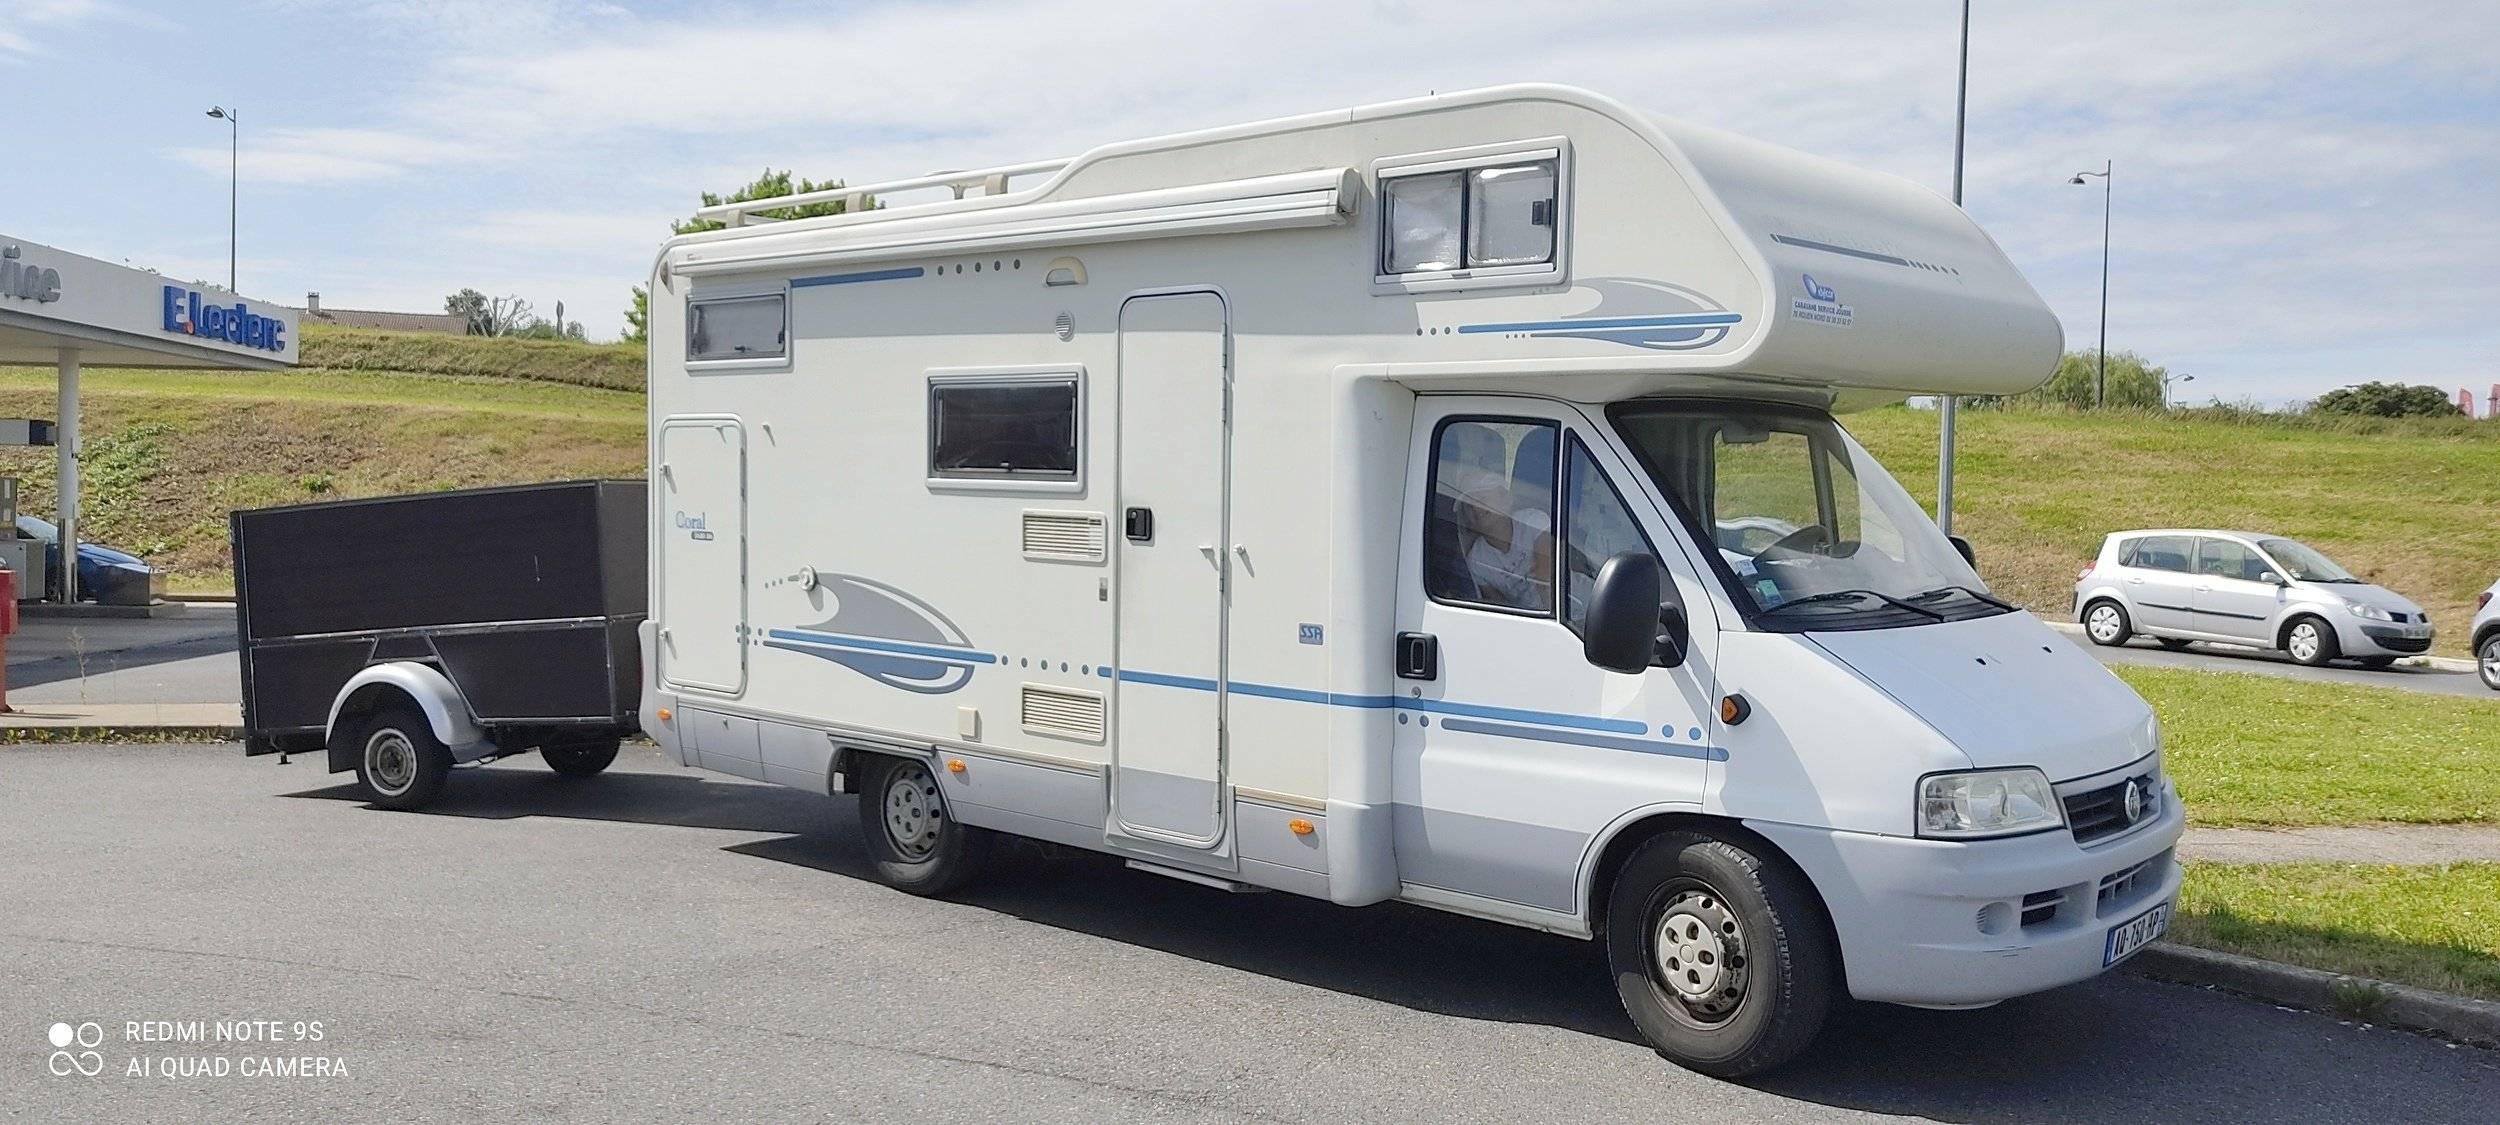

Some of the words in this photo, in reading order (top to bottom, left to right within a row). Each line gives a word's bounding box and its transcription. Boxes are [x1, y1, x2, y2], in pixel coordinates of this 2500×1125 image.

[0, 245, 61, 303] ice
[163, 285, 286, 352] E.Leclerc
[675, 510, 706, 530] Coral
